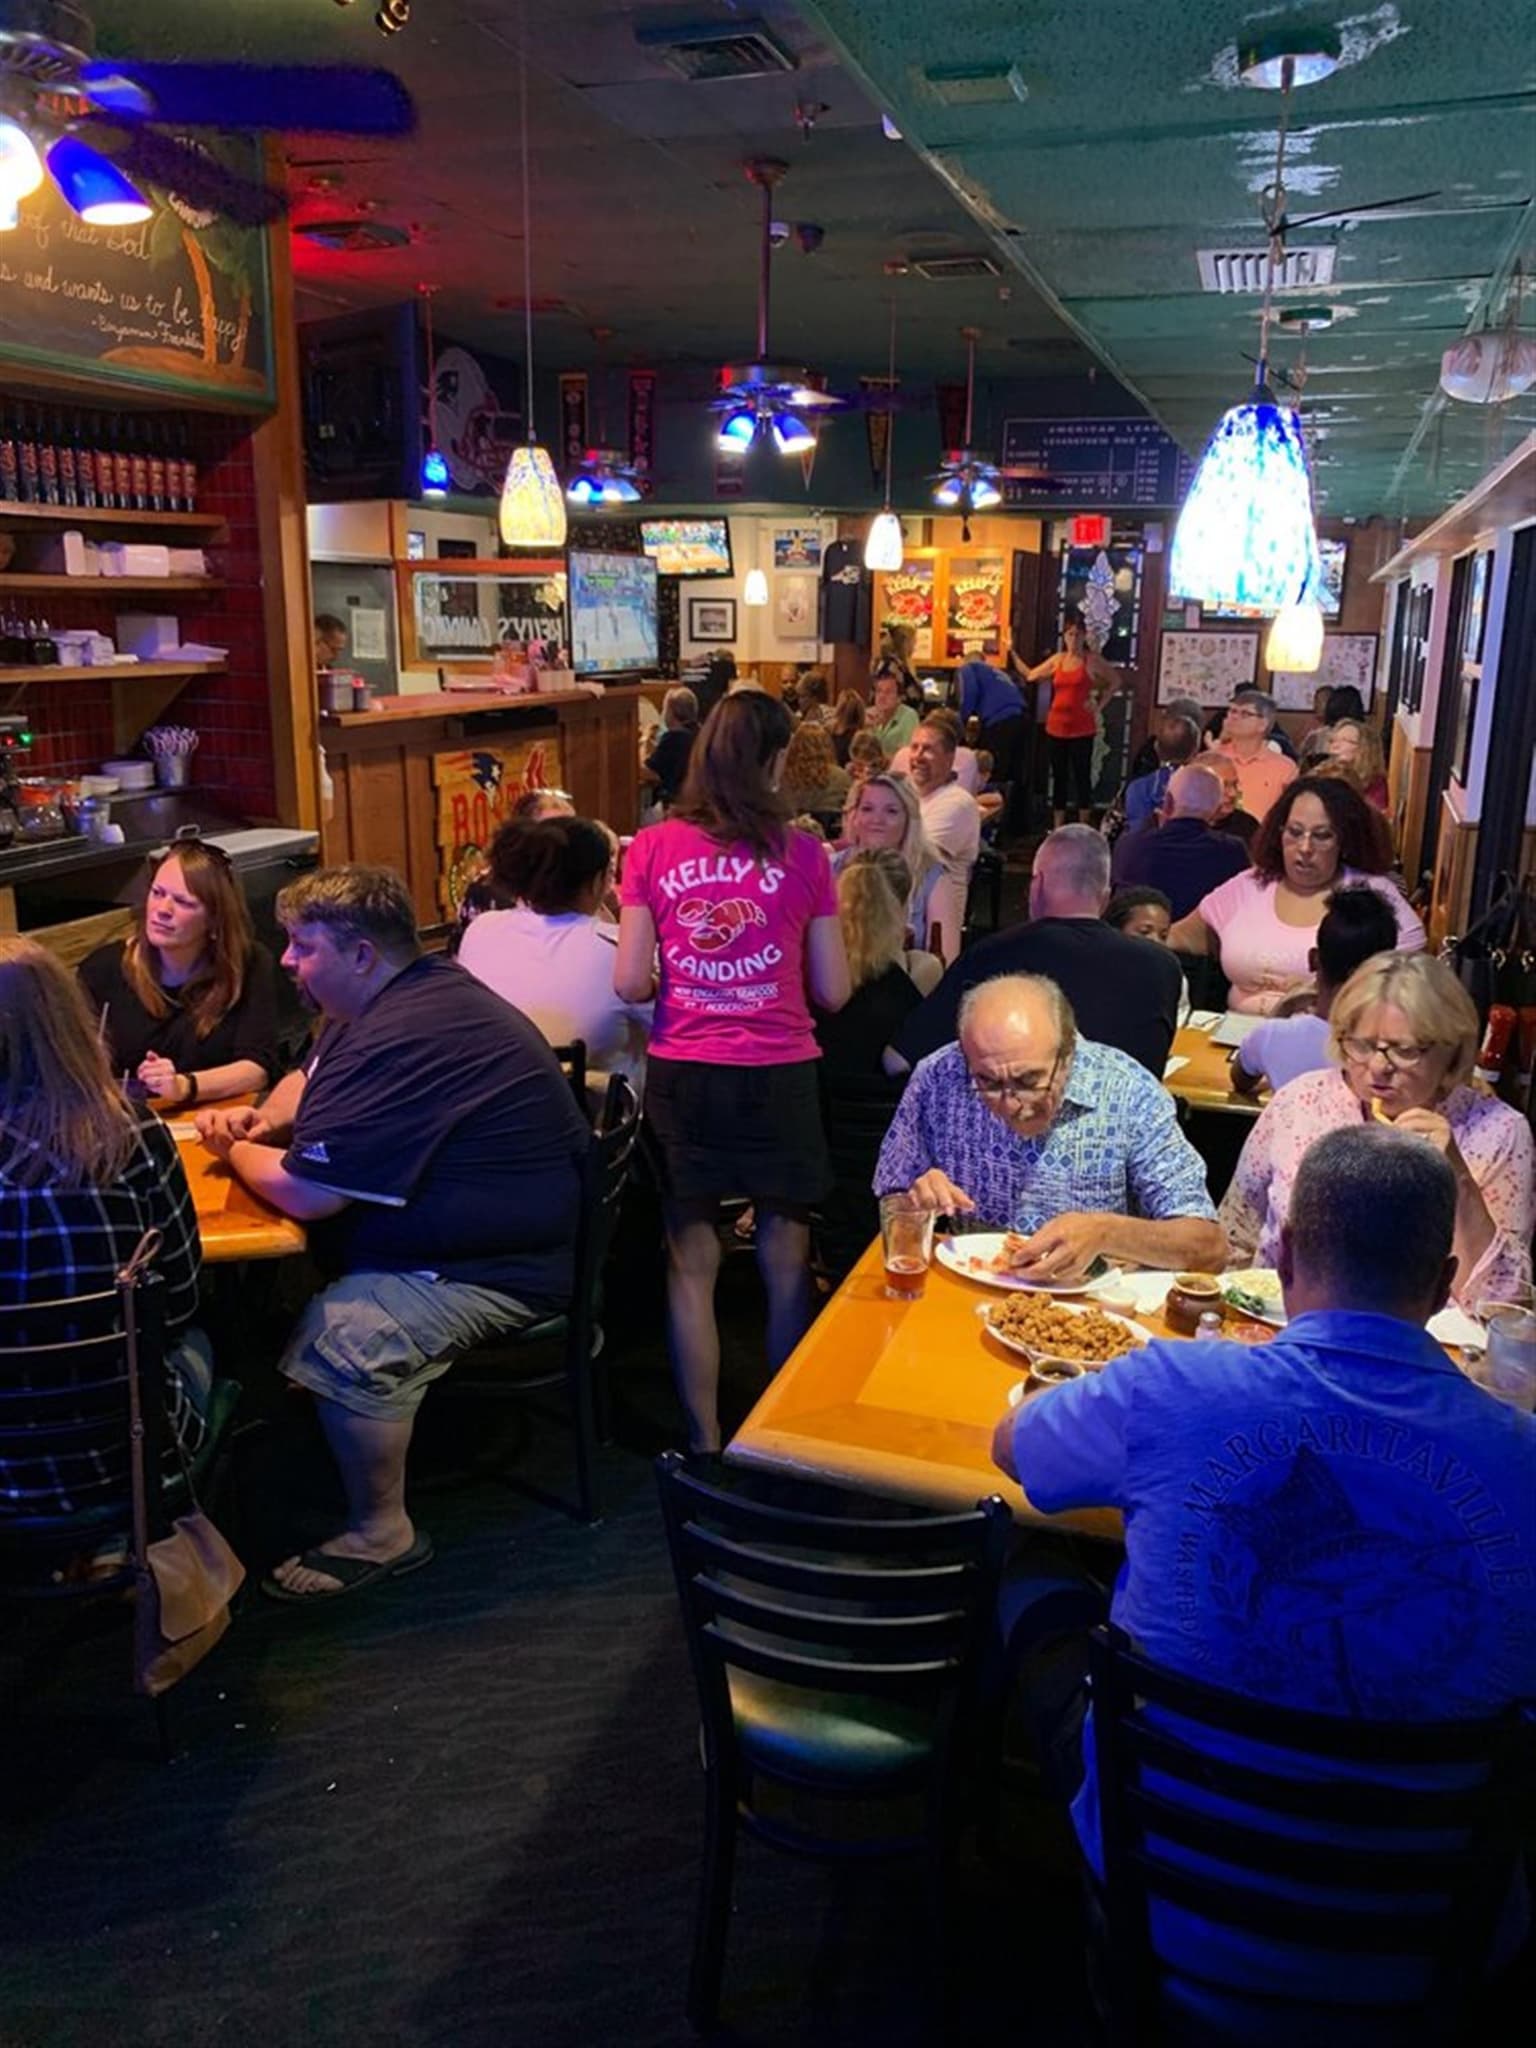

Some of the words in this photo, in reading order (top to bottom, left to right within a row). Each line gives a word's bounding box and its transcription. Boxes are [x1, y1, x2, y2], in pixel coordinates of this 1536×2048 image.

[23, 265, 60, 294] and
[61, 279, 115, 305] wants
[119, 291, 143, 312] us
[144, 293, 167, 318] to
[171, 285, 195, 327] be
[658, 856, 786, 899] KELLY'S
[666, 944, 783, 981] LANDING
[1182, 1414, 1536, 1594] MARGARITAVILLE
